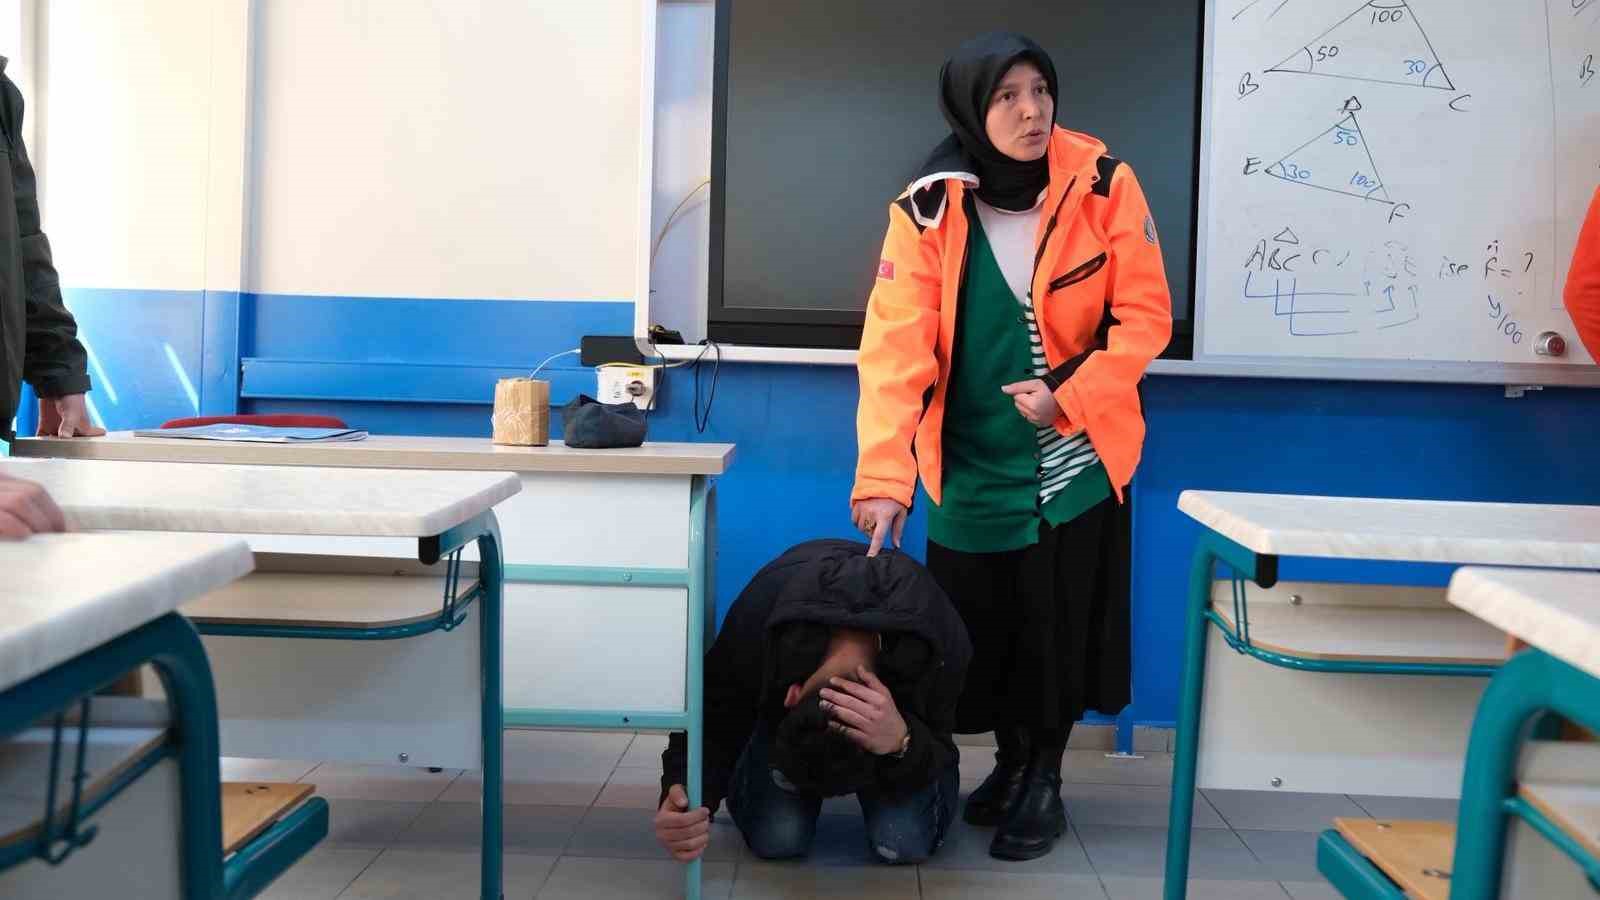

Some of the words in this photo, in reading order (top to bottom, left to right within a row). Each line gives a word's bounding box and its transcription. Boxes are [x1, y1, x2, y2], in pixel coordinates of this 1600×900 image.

[1371, 9, 1403, 25] 100
[1315, 46, 1339, 62] 50
[1403, 59, 1426, 76] 30
[1449, 94, 1473, 112] C
[1333, 130, 1359, 146] 50
[1242, 157, 1262, 176] E
[1387, 203, 1411, 225] F
